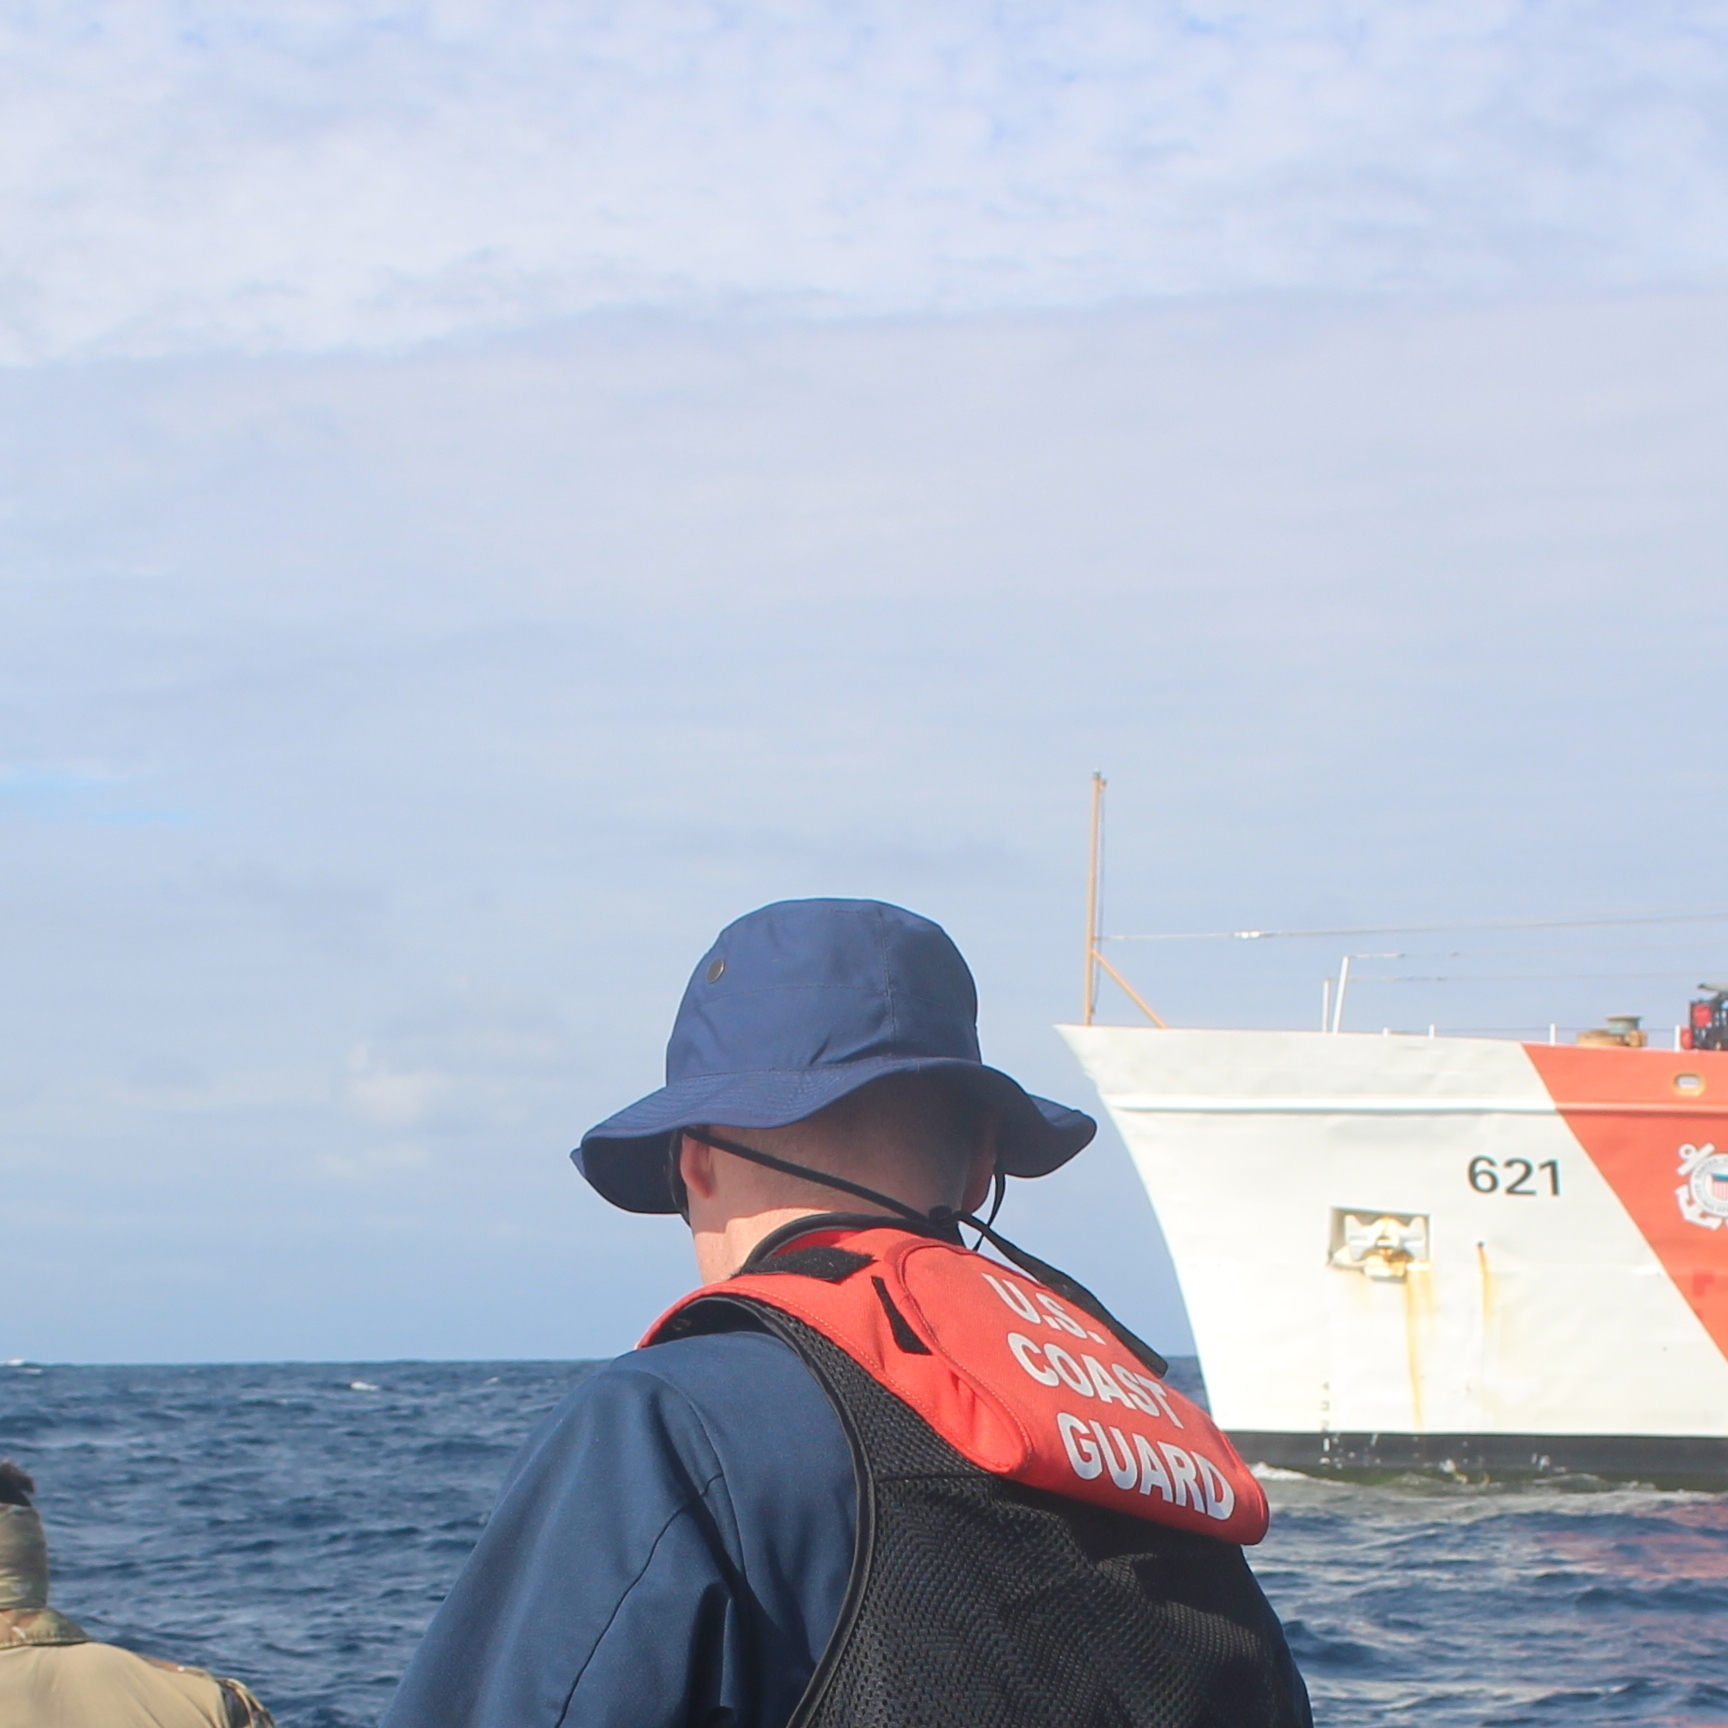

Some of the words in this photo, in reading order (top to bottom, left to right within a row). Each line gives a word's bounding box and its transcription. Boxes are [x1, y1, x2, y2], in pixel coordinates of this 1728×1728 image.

[1467, 1154, 1560, 1197] 621
[982, 1272, 1107, 1346] U.S.
[1007, 1332, 1185, 1429] COAST
[1056, 1411, 1236, 1521] GUARD
